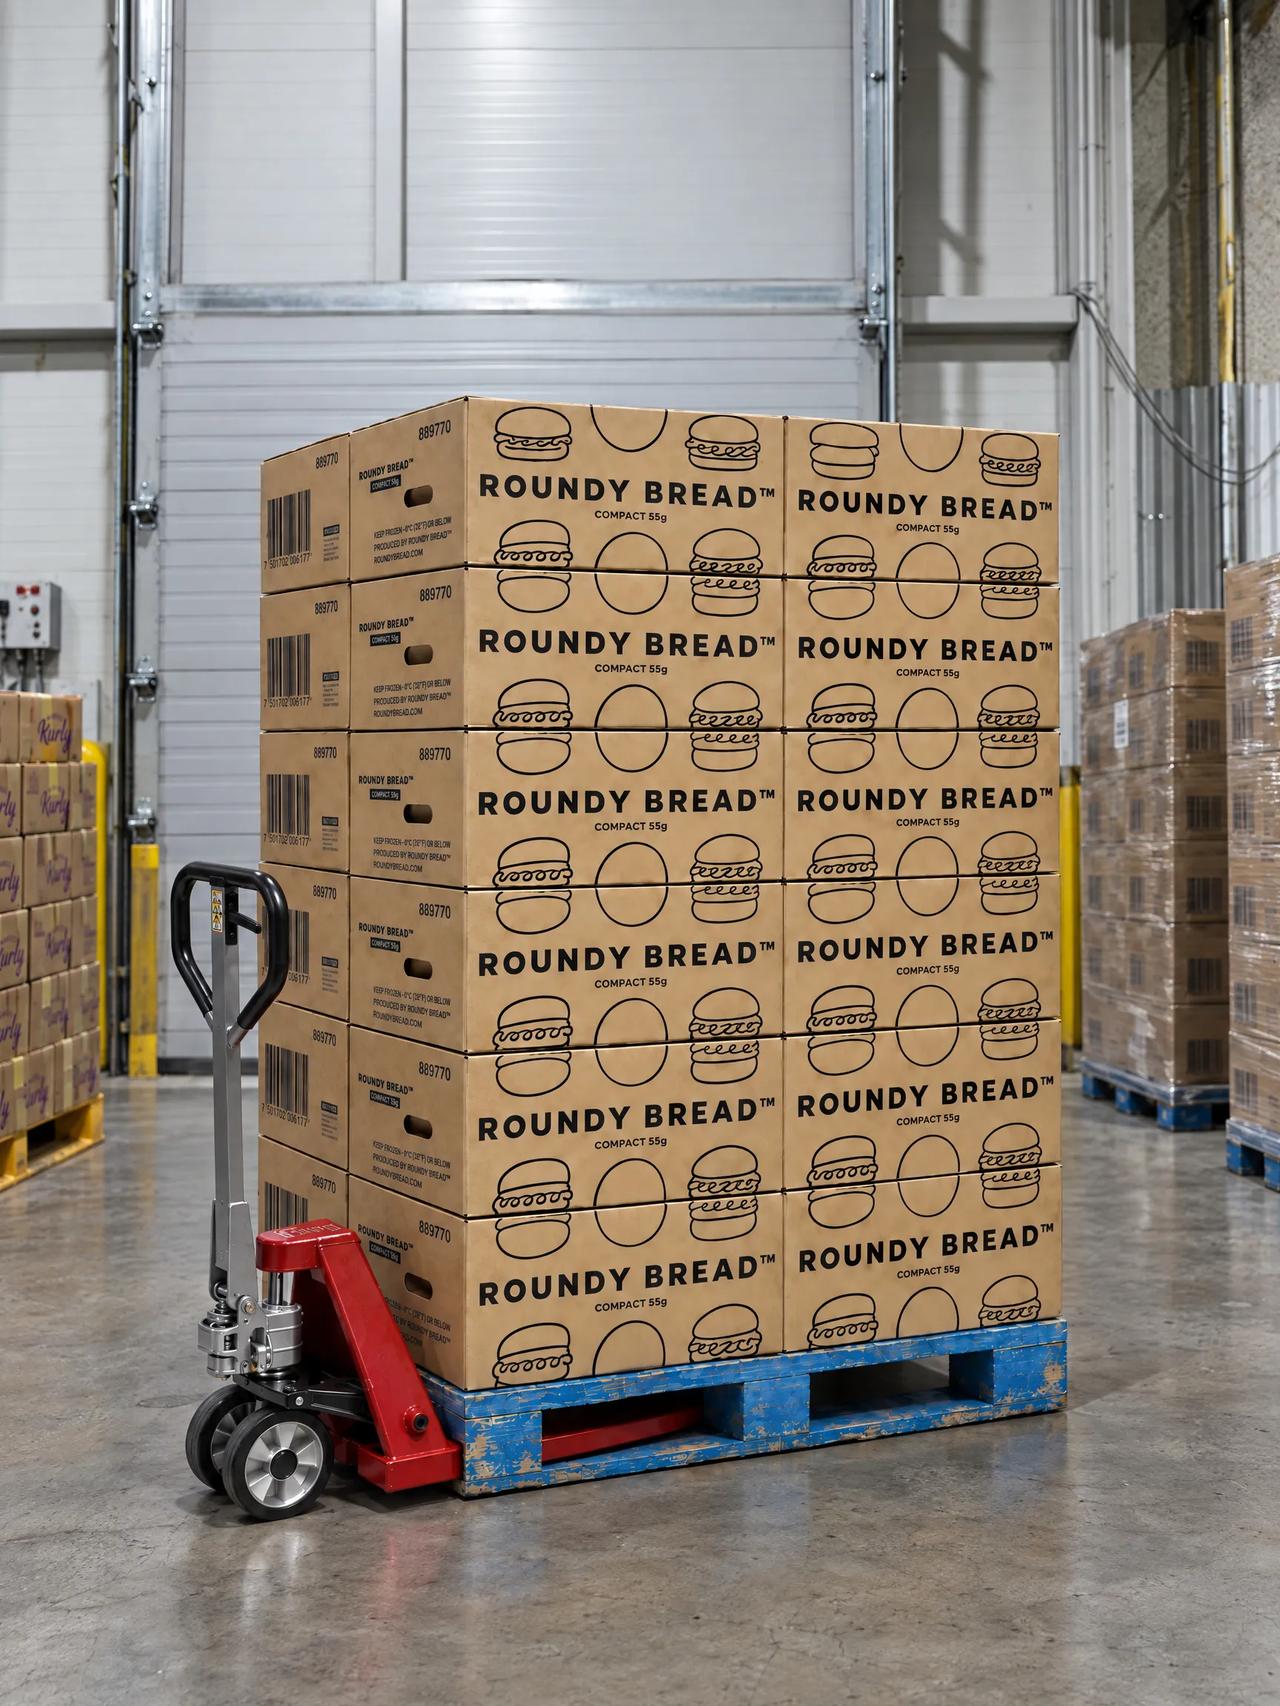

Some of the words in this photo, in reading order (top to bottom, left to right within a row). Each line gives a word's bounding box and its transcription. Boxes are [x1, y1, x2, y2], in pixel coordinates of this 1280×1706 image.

[418, 418, 451, 440] 889770
[315, 452, 338, 469] 889770
[358, 465, 385, 480] ROUNDY
[480, 474, 630, 502] ROUNDY
[645, 481, 774, 508] BREAD™
[799, 490, 927, 515] ROUNDY
[942, 496, 1052, 521] BREAD™
[595, 511, 646, 520] COMPACT
[649, 513, 666, 523] 55g
[896, 524, 940, 532] COMPACT
[944, 525, 959, 535] 55g
[373, 539, 400, 551] PRODUCED
[400, 538, 407, 546] BY
[408, 533, 428, 545] ROUNDY
[419, 584, 451, 601] 889770
[314, 600, 338, 614] 889770
[359, 620, 385, 632] ROUNDY
[480, 629, 630, 655] ROUNDY
[646, 633, 775, 657] BREAD™
[799, 637, 928, 660] ROUNDY
[942, 639, 1052, 662] BREAD™
[595, 664, 646, 672] COMPACT
[650, 665, 667, 675] 55g
[944, 669, 959, 679] 55g
[373, 696, 399, 705] PRODUCED
[400, 695, 406, 703] BY
[407, 694, 428, 703] ROUNDY
[38, 718, 71, 754] Kurly
[313, 747, 337, 759] 889770
[418, 747, 450, 760] 889770
[358, 775, 385, 784] ROUNDY
[41, 787, 70, 825] Kurly
[479, 790, 630, 815] ROUNDY
[645, 790, 775, 812] BREAD™
[798, 789, 928, 811] ROUNDY
[942, 788, 1052, 809] BREAD™
[595, 822, 646, 831] COMPACT
[649, 822, 667, 832] 55g
[896, 818, 941, 826] COMPACT
[944, 818, 959, 827] 55g
[373, 848, 398, 858] PRODUCED
[400, 850, 407, 858] BY
[407, 851, 428, 860] ROUNDY
[312, 885, 337, 900] 889770
[418, 901, 450, 920] 889770
[358, 921, 385, 935] ROUNDY
[798, 936, 928, 962] ROUNDY
[942, 931, 1053, 955] BREAD™
[479, 946, 630, 976] ROUNDY
[645, 941, 774, 968] BREAD™
[897, 966, 941, 975] COMPACT
[944, 965, 959, 974] 55g
[595, 978, 646, 988] COMPACT
[649, 977, 667, 987] 55g
[373, 997, 398, 1011] PRODUCED
[400, 1003, 406, 1012] BY
[407, 1004, 428, 1017] ROUNDY
[313, 1029, 336, 1047] 889770
[418, 1059, 450, 1082] 889770
[358, 1072, 384, 1089] ROUNDY
[798, 1086, 928, 1117] ROUNDY
[942, 1076, 1053, 1105] BREAD™
[479, 1106, 630, 1141] ROUNDY
[645, 1097, 775, 1128] BREAD™
[897, 1115, 942, 1126] COMPACT
[944, 1114, 959, 1123] 55g
[595, 1138, 646, 1149] COMPACT
[649, 1137, 667, 1146] 55g
[372, 1151, 398, 1169] PRODUCED
[400, 1160, 406, 1171] BY
[407, 1161, 427, 1178] ROUNDY
[312, 1174, 336, 1194] 889770
[358, 1222, 384, 1243] ROUNDY
[418, 1218, 450, 1245] 889770
[800, 1237, 928, 1272] ROUNDY
[942, 1223, 1053, 1256] BREAD™
[479, 1268, 630, 1306] ROUNDY
[645, 1254, 775, 1288] BREAD™
[897, 1267, 942, 1278] COMPACT
[944, 1265, 960, 1274] 55g
[595, 1299, 646, 1312] COMPACT
[649, 1298, 667, 1307] 55g
